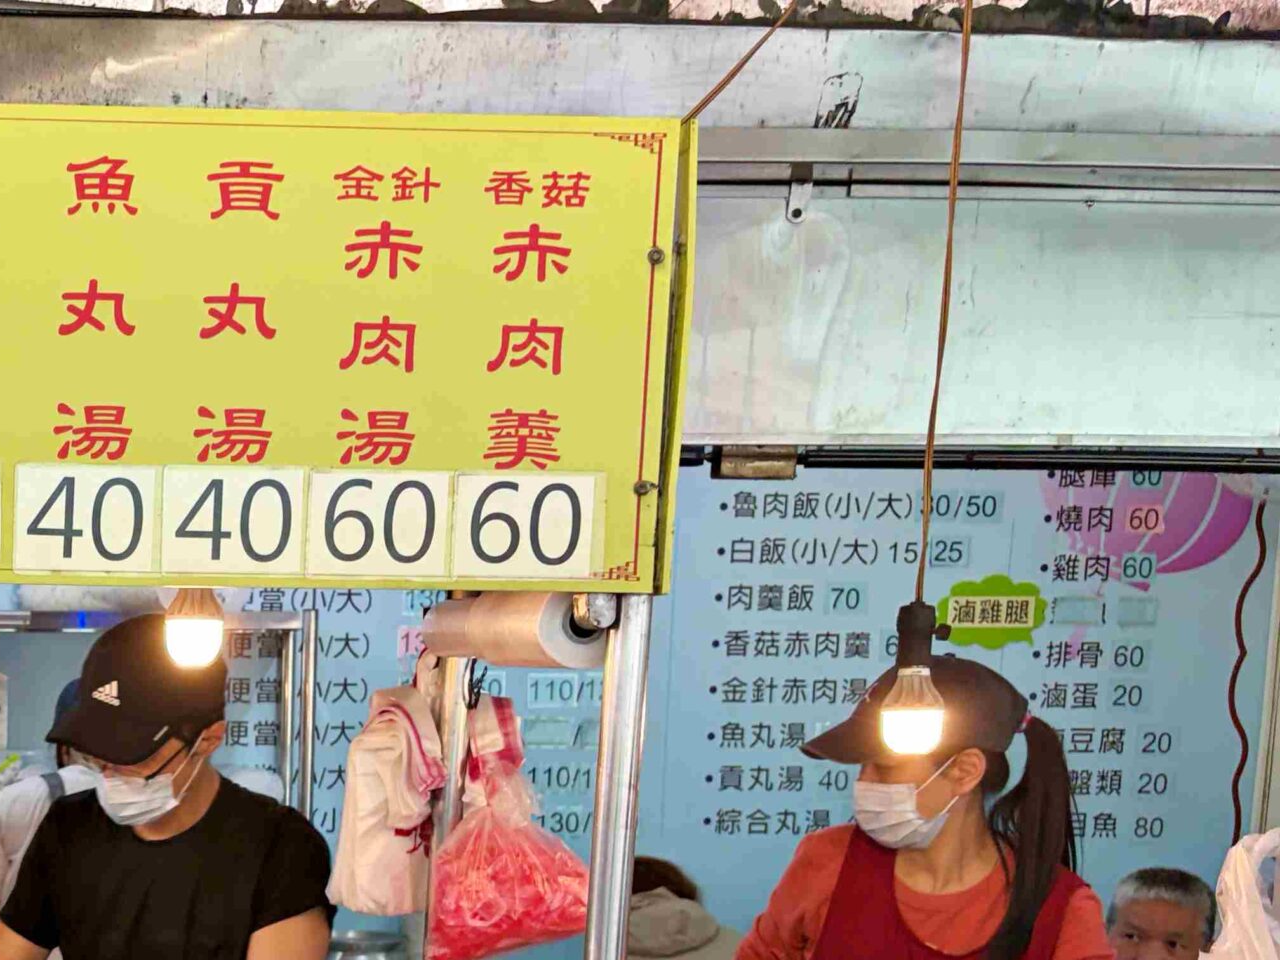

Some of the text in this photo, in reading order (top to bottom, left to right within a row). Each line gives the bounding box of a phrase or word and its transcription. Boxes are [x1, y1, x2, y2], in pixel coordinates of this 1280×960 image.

[53, 156, 138, 461] 魚丸湯
[194, 161, 285, 463] 貢丸湯
[26, 475, 144, 562] 40
[732, 490, 913, 520] 魯肉飯(小/大)
[1055, 505, 1160, 533] 燒肉 60
[175, 478, 293, 564] 40
[323, 478, 436, 564] 60
[470, 481, 583, 567] 60
[729, 537, 879, 566] 白飯(小/大)
[1052, 554, 1153, 582] 雞肉 60
[726, 584, 861, 613] 肉羹飯 70
[723, 630, 871, 659] 香菇赤肉羹
[1044, 641, 1145, 668] 排骨 60
[722, 677, 869, 705] 金針赤肉湯
[1040, 682, 1143, 709] 滷蛋 20
[719, 722, 806, 749] 魚丸湯
[1056, 727, 1172, 754] 豆腐 20
[718, 765, 849, 792] 貢丸湯 40
[1137, 773, 1168, 795] 20
[713, 808, 831, 836] 綜合丸湯
[1134, 816, 1164, 838] 80
